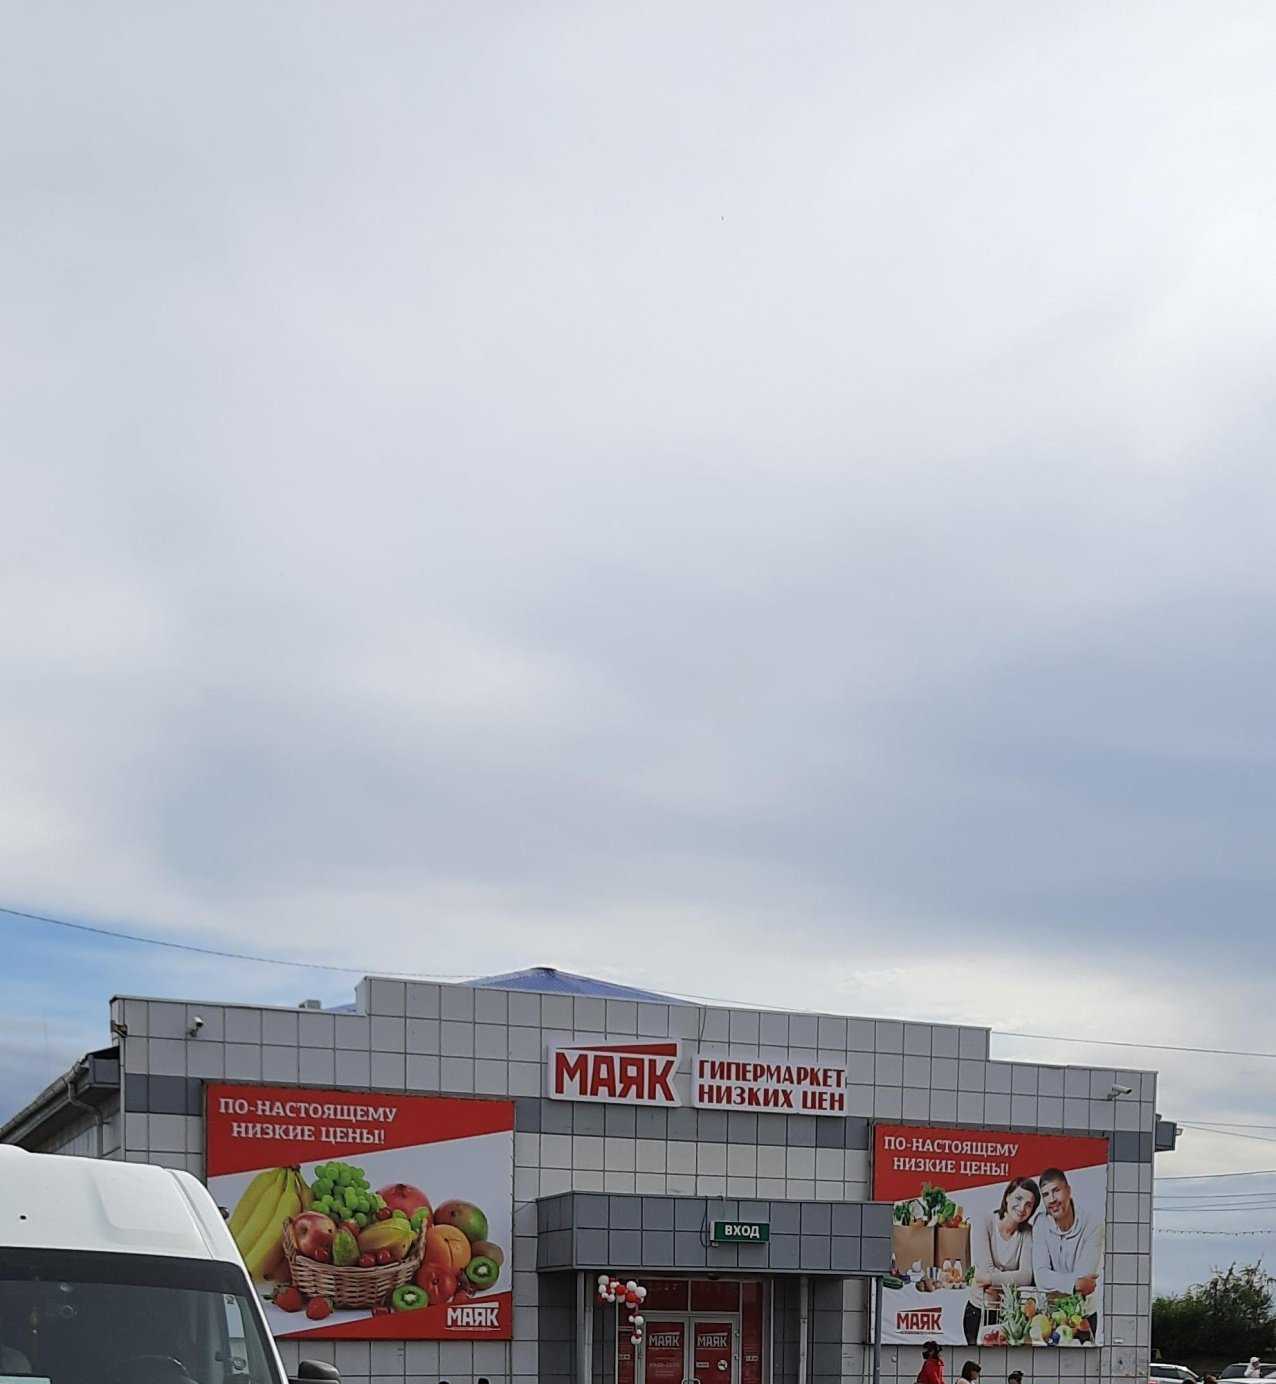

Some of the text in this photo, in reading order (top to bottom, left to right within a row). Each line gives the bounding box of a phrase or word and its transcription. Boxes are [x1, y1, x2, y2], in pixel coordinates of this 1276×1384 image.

[555, 1052, 675, 1101] МАЯК
[699, 1059, 846, 1088] ГИПЕРМАРКЕТ
[699, 1084, 845, 1111] НИЗКИХ ЦЕН
[219, 1098, 397, 1123] ПО-НАСТОЯЩЕМУ
[232, 1122, 385, 1144] НИЗКИЕ ЦЕНЫ!
[884, 1136, 1019, 1158] ПО-НАСТОЯЩЕМУ
[893, 1157, 1009, 1176] НИЗКИЕ ЦЕНЫ!
[725, 1224, 760, 1239] ВХОД
[447, 1307, 499, 1326] МАЯК
[896, 1312, 942, 1331] МАЯК
[649, 1335, 680, 1347] МАЯК
[697, 1335, 727, 1347] МАЯК
